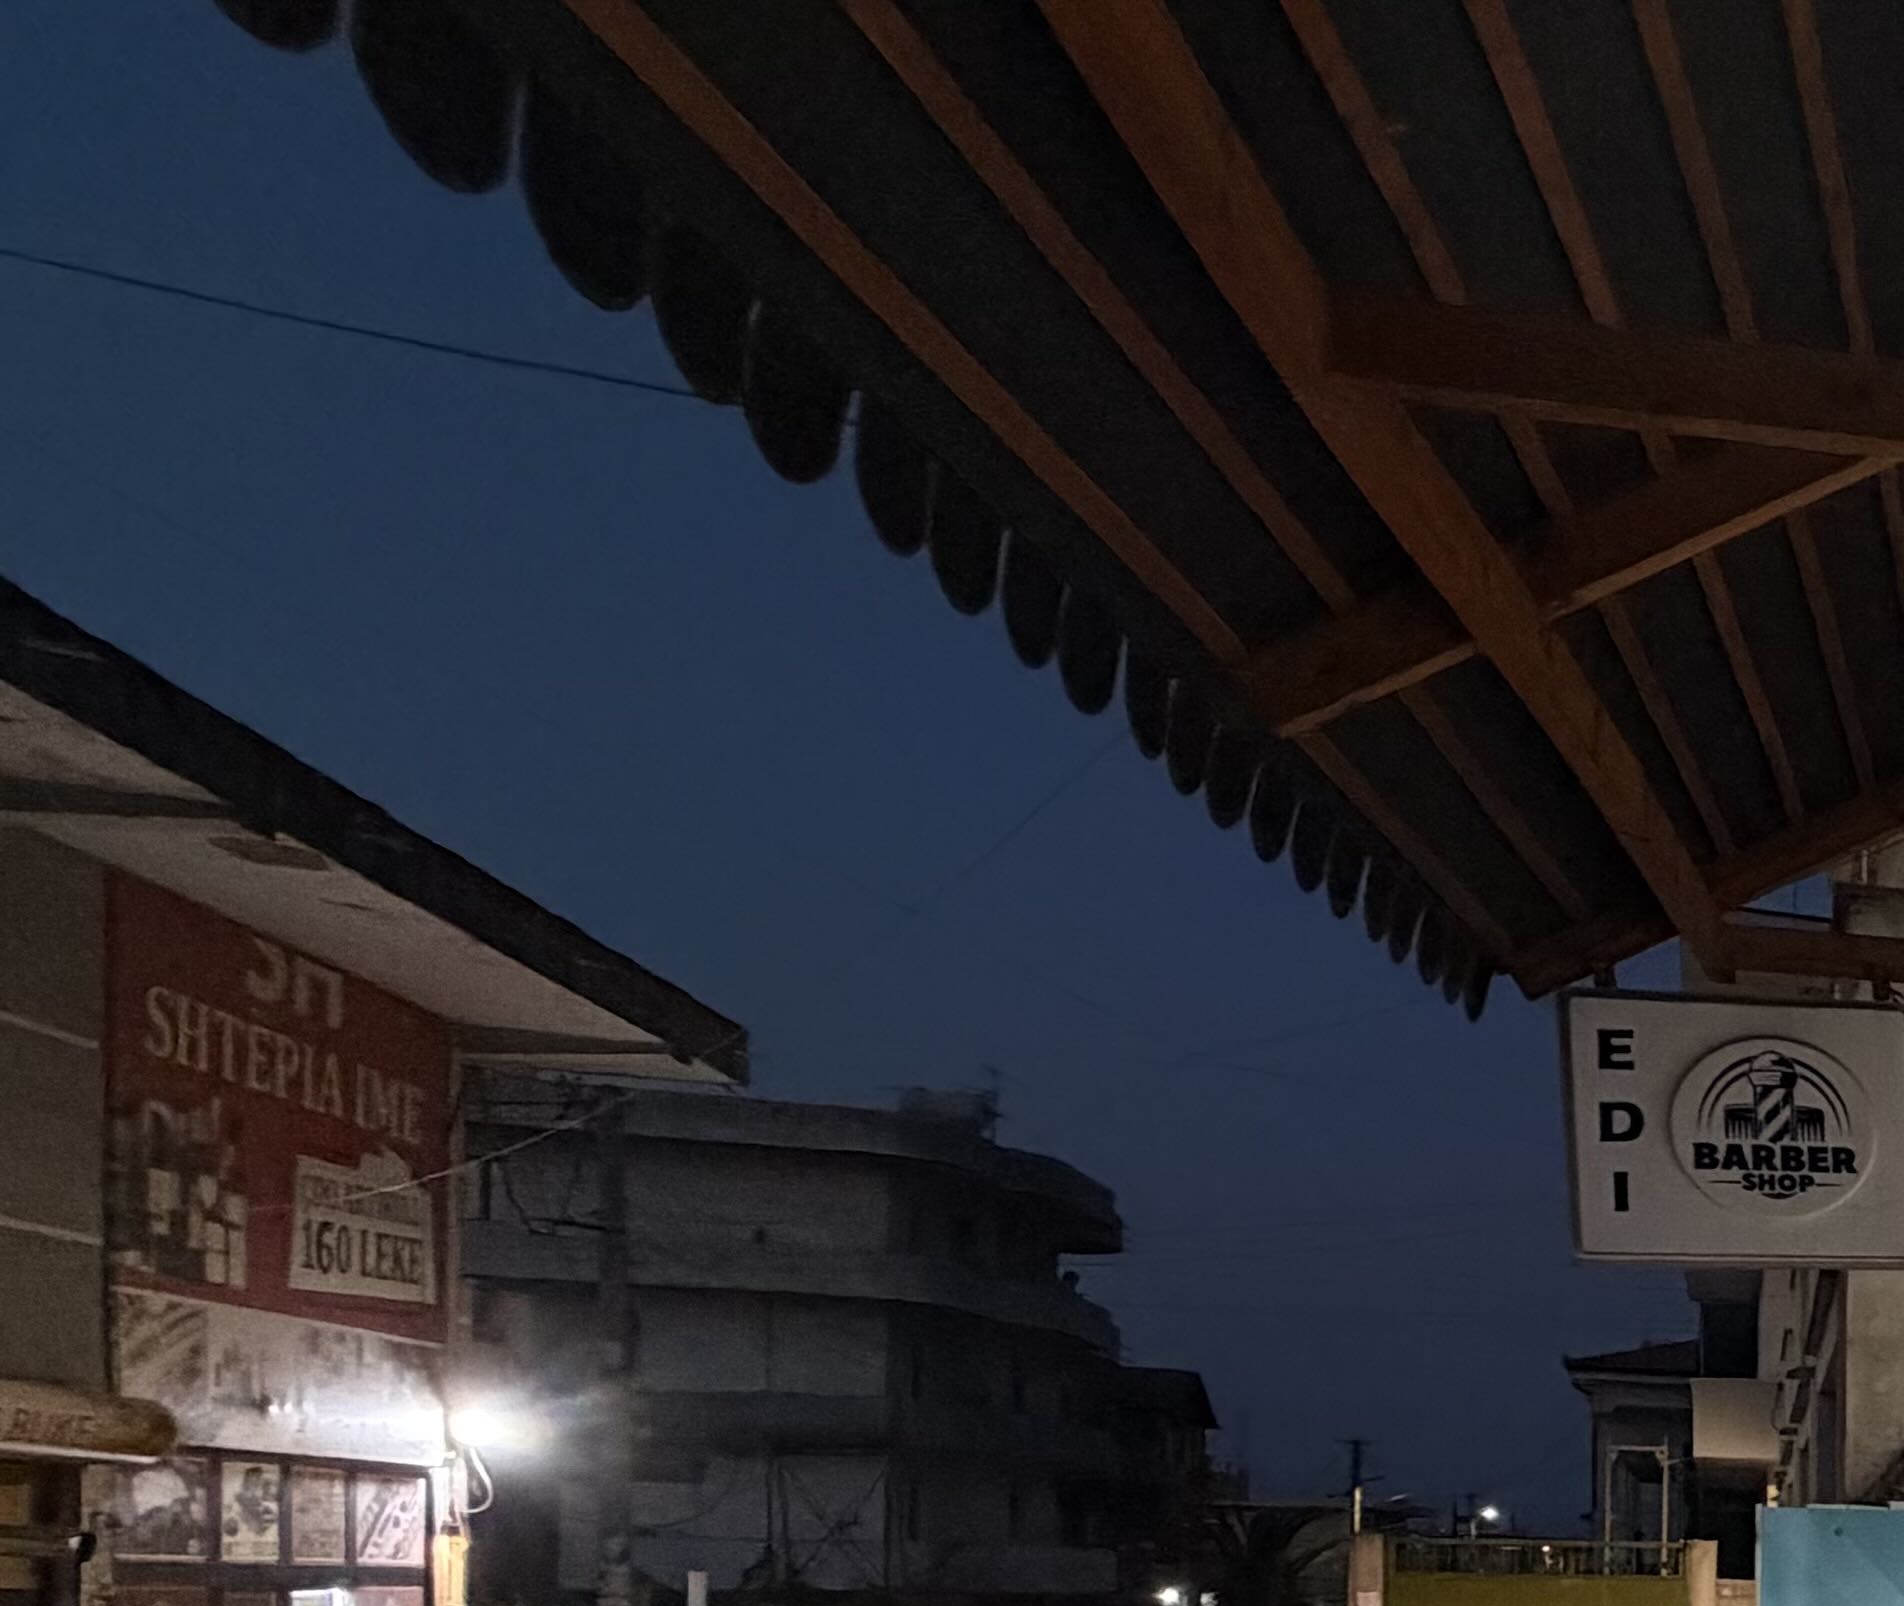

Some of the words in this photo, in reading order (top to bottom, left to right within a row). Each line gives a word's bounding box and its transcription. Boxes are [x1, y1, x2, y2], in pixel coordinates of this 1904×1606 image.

[145, 985, 343, 1118] SHTEPIA
[1597, 1028, 1645, 1212] EDI
[1692, 1141, 1858, 1175] BARBER
[1741, 1172, 1815, 1194] SHOP
[302, 1219, 351, 1275] 160
